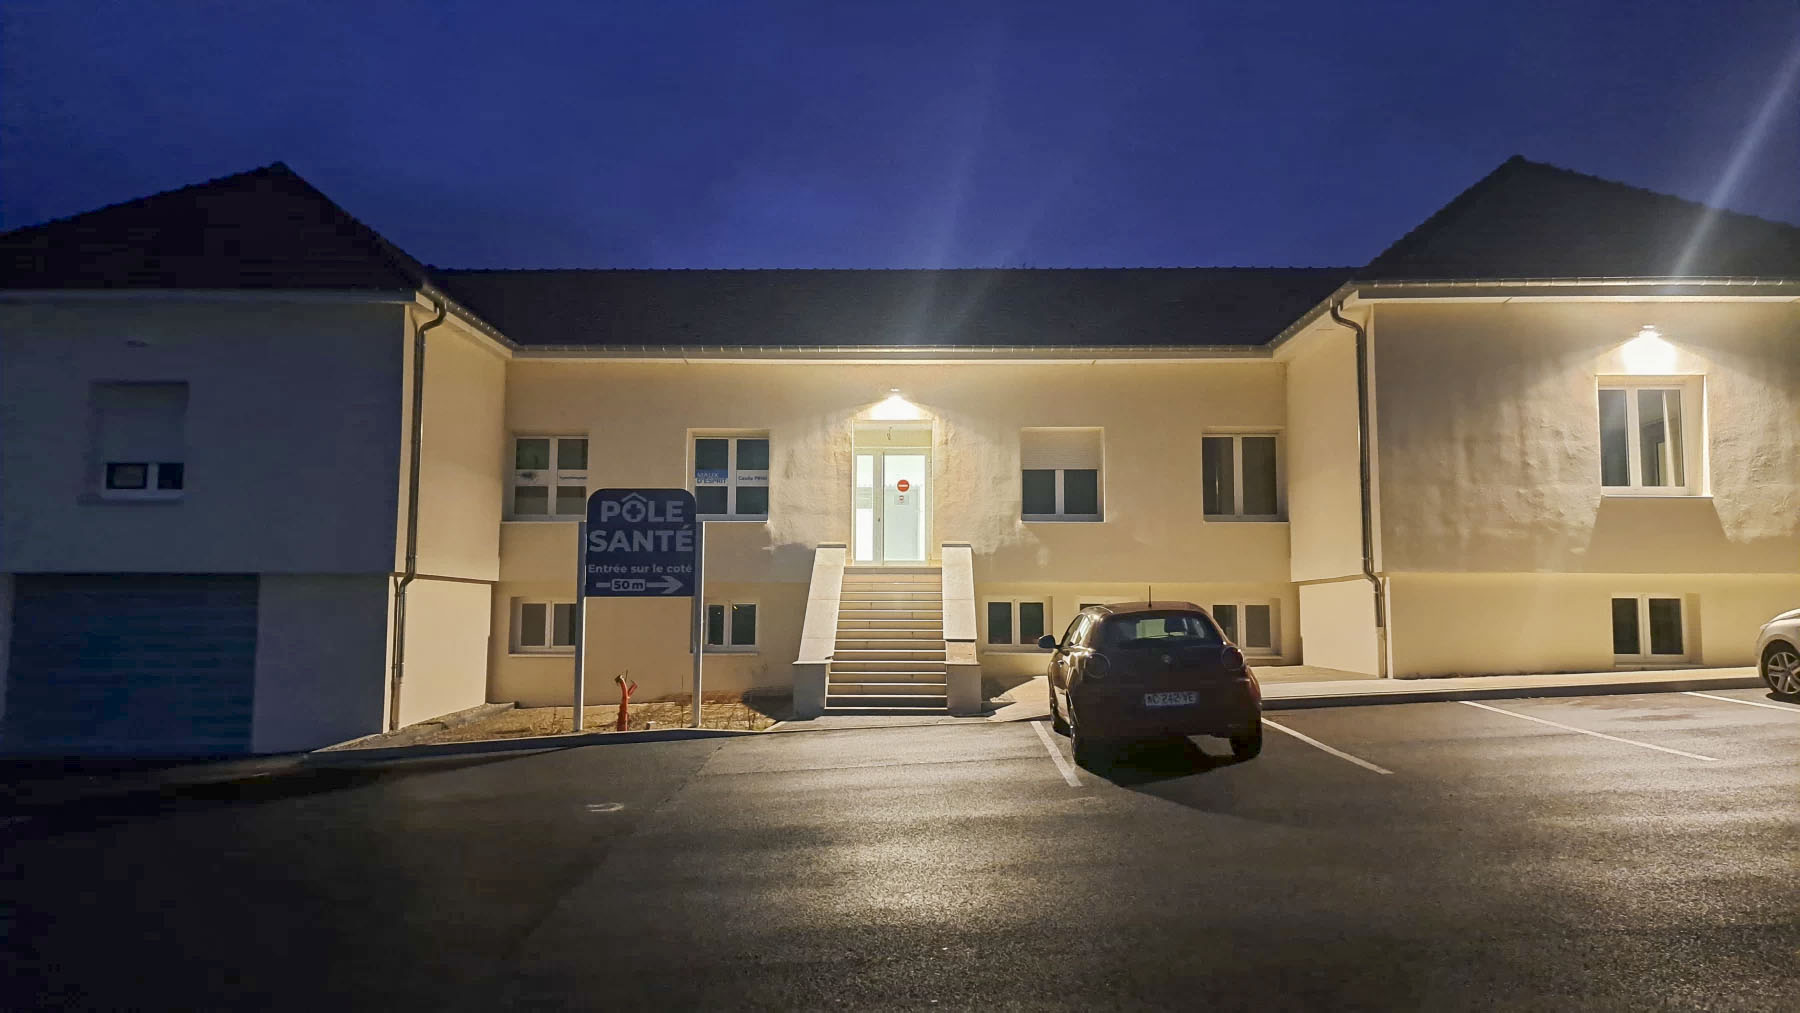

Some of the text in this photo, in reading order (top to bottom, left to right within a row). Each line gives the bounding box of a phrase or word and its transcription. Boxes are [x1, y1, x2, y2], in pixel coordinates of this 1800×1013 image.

[601, 492, 684, 523] PÔLE
[589, 524, 693, 552] SANTÉ
[588, 564, 627, 574] Entrée
[630, 565, 650, 574] sur
[652, 564, 663, 574] le
[613, 581, 644, 590] 50 m
